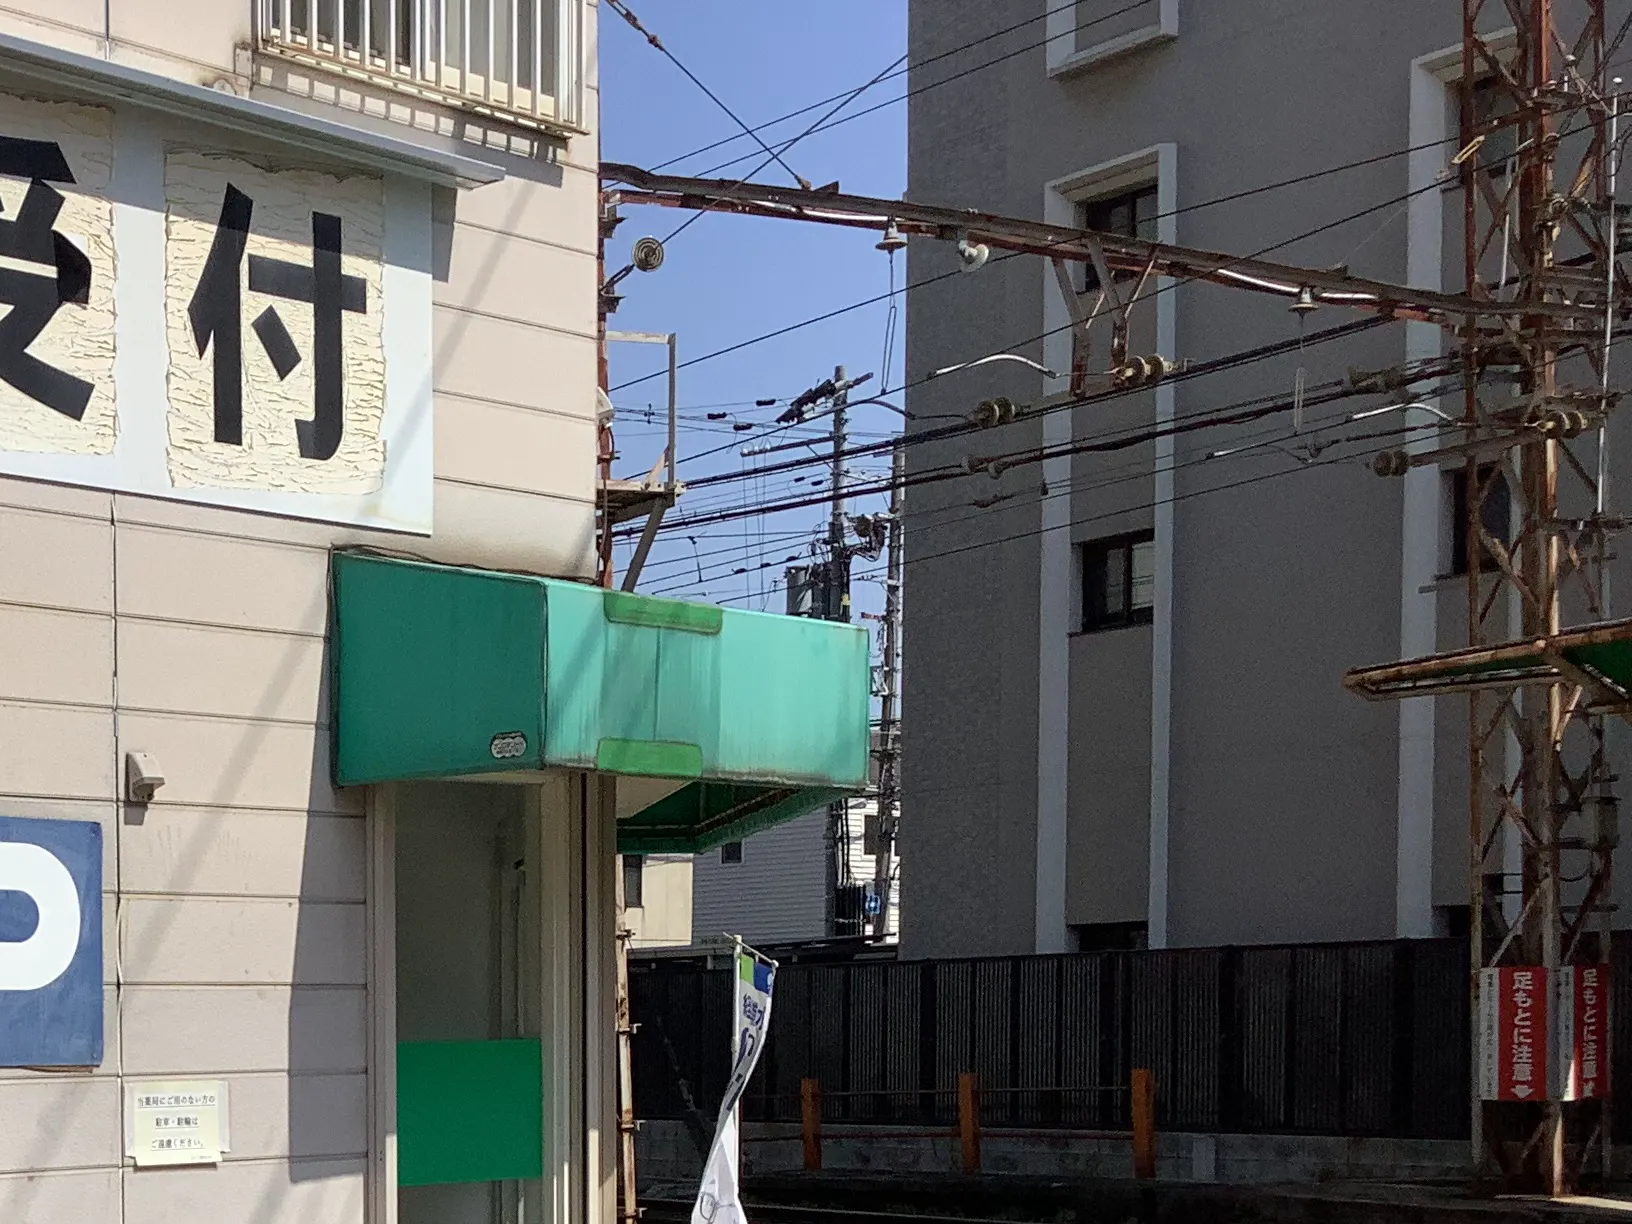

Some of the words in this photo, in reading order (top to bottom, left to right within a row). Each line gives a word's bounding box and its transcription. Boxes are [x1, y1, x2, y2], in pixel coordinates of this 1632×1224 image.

[137, 1095, 216, 1107] 当薬局にご用のない方の
